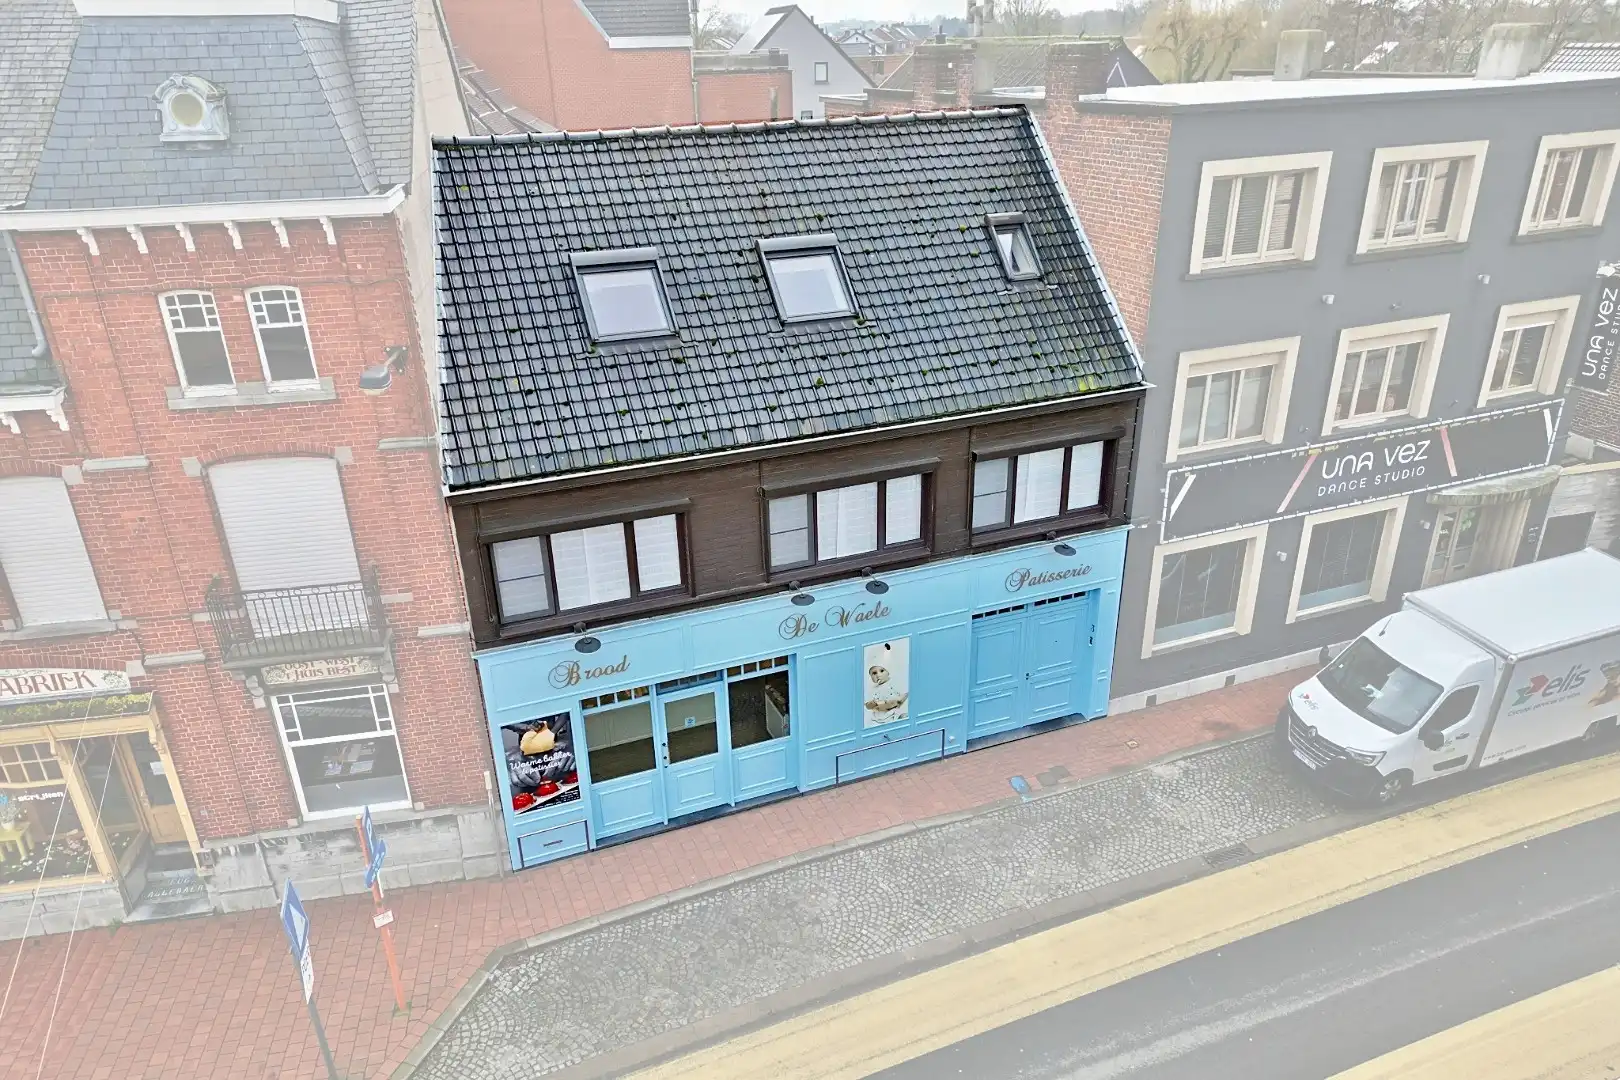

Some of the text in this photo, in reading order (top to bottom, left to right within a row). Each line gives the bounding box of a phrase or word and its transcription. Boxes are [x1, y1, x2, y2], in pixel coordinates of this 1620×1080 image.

[1598, 340, 1615, 380] DANCE
[1317, 466, 1425, 497] DANCE STUDIO
[1004, 563, 1092, 593] Patisserie
[779, 600, 892, 641] De Waele
[548, 654, 631, 689] Brood
[1541, 664, 1591, 698] elis
[509, 758, 543, 770] Warme
